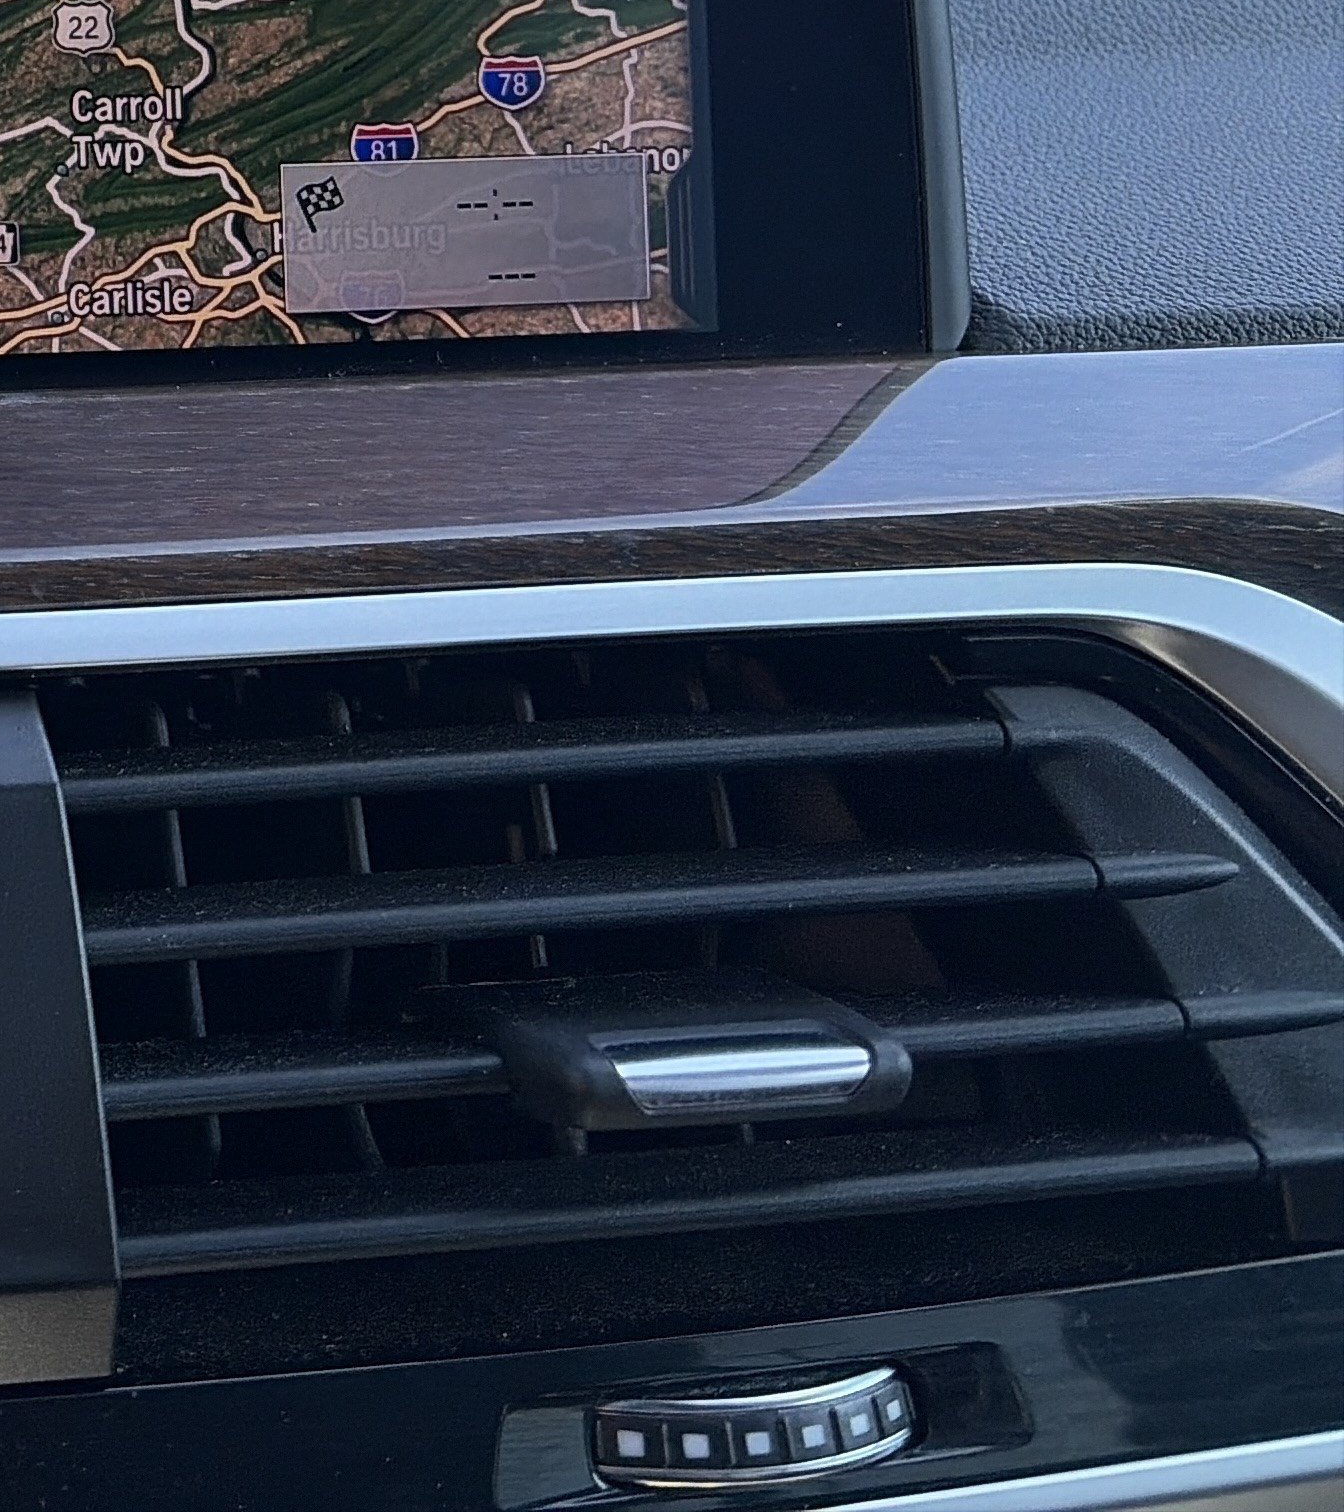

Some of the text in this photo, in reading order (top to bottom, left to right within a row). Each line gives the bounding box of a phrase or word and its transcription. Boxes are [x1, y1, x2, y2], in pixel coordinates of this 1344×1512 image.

[69, 17, 97, 39] 22
[498, 74, 526, 96] 78
[72, 89, 182, 122] Carroll
[72, 136, 144, 171] Twp
[371, 141, 396, 160] 81
[68, 283, 192, 314] Carlisle
